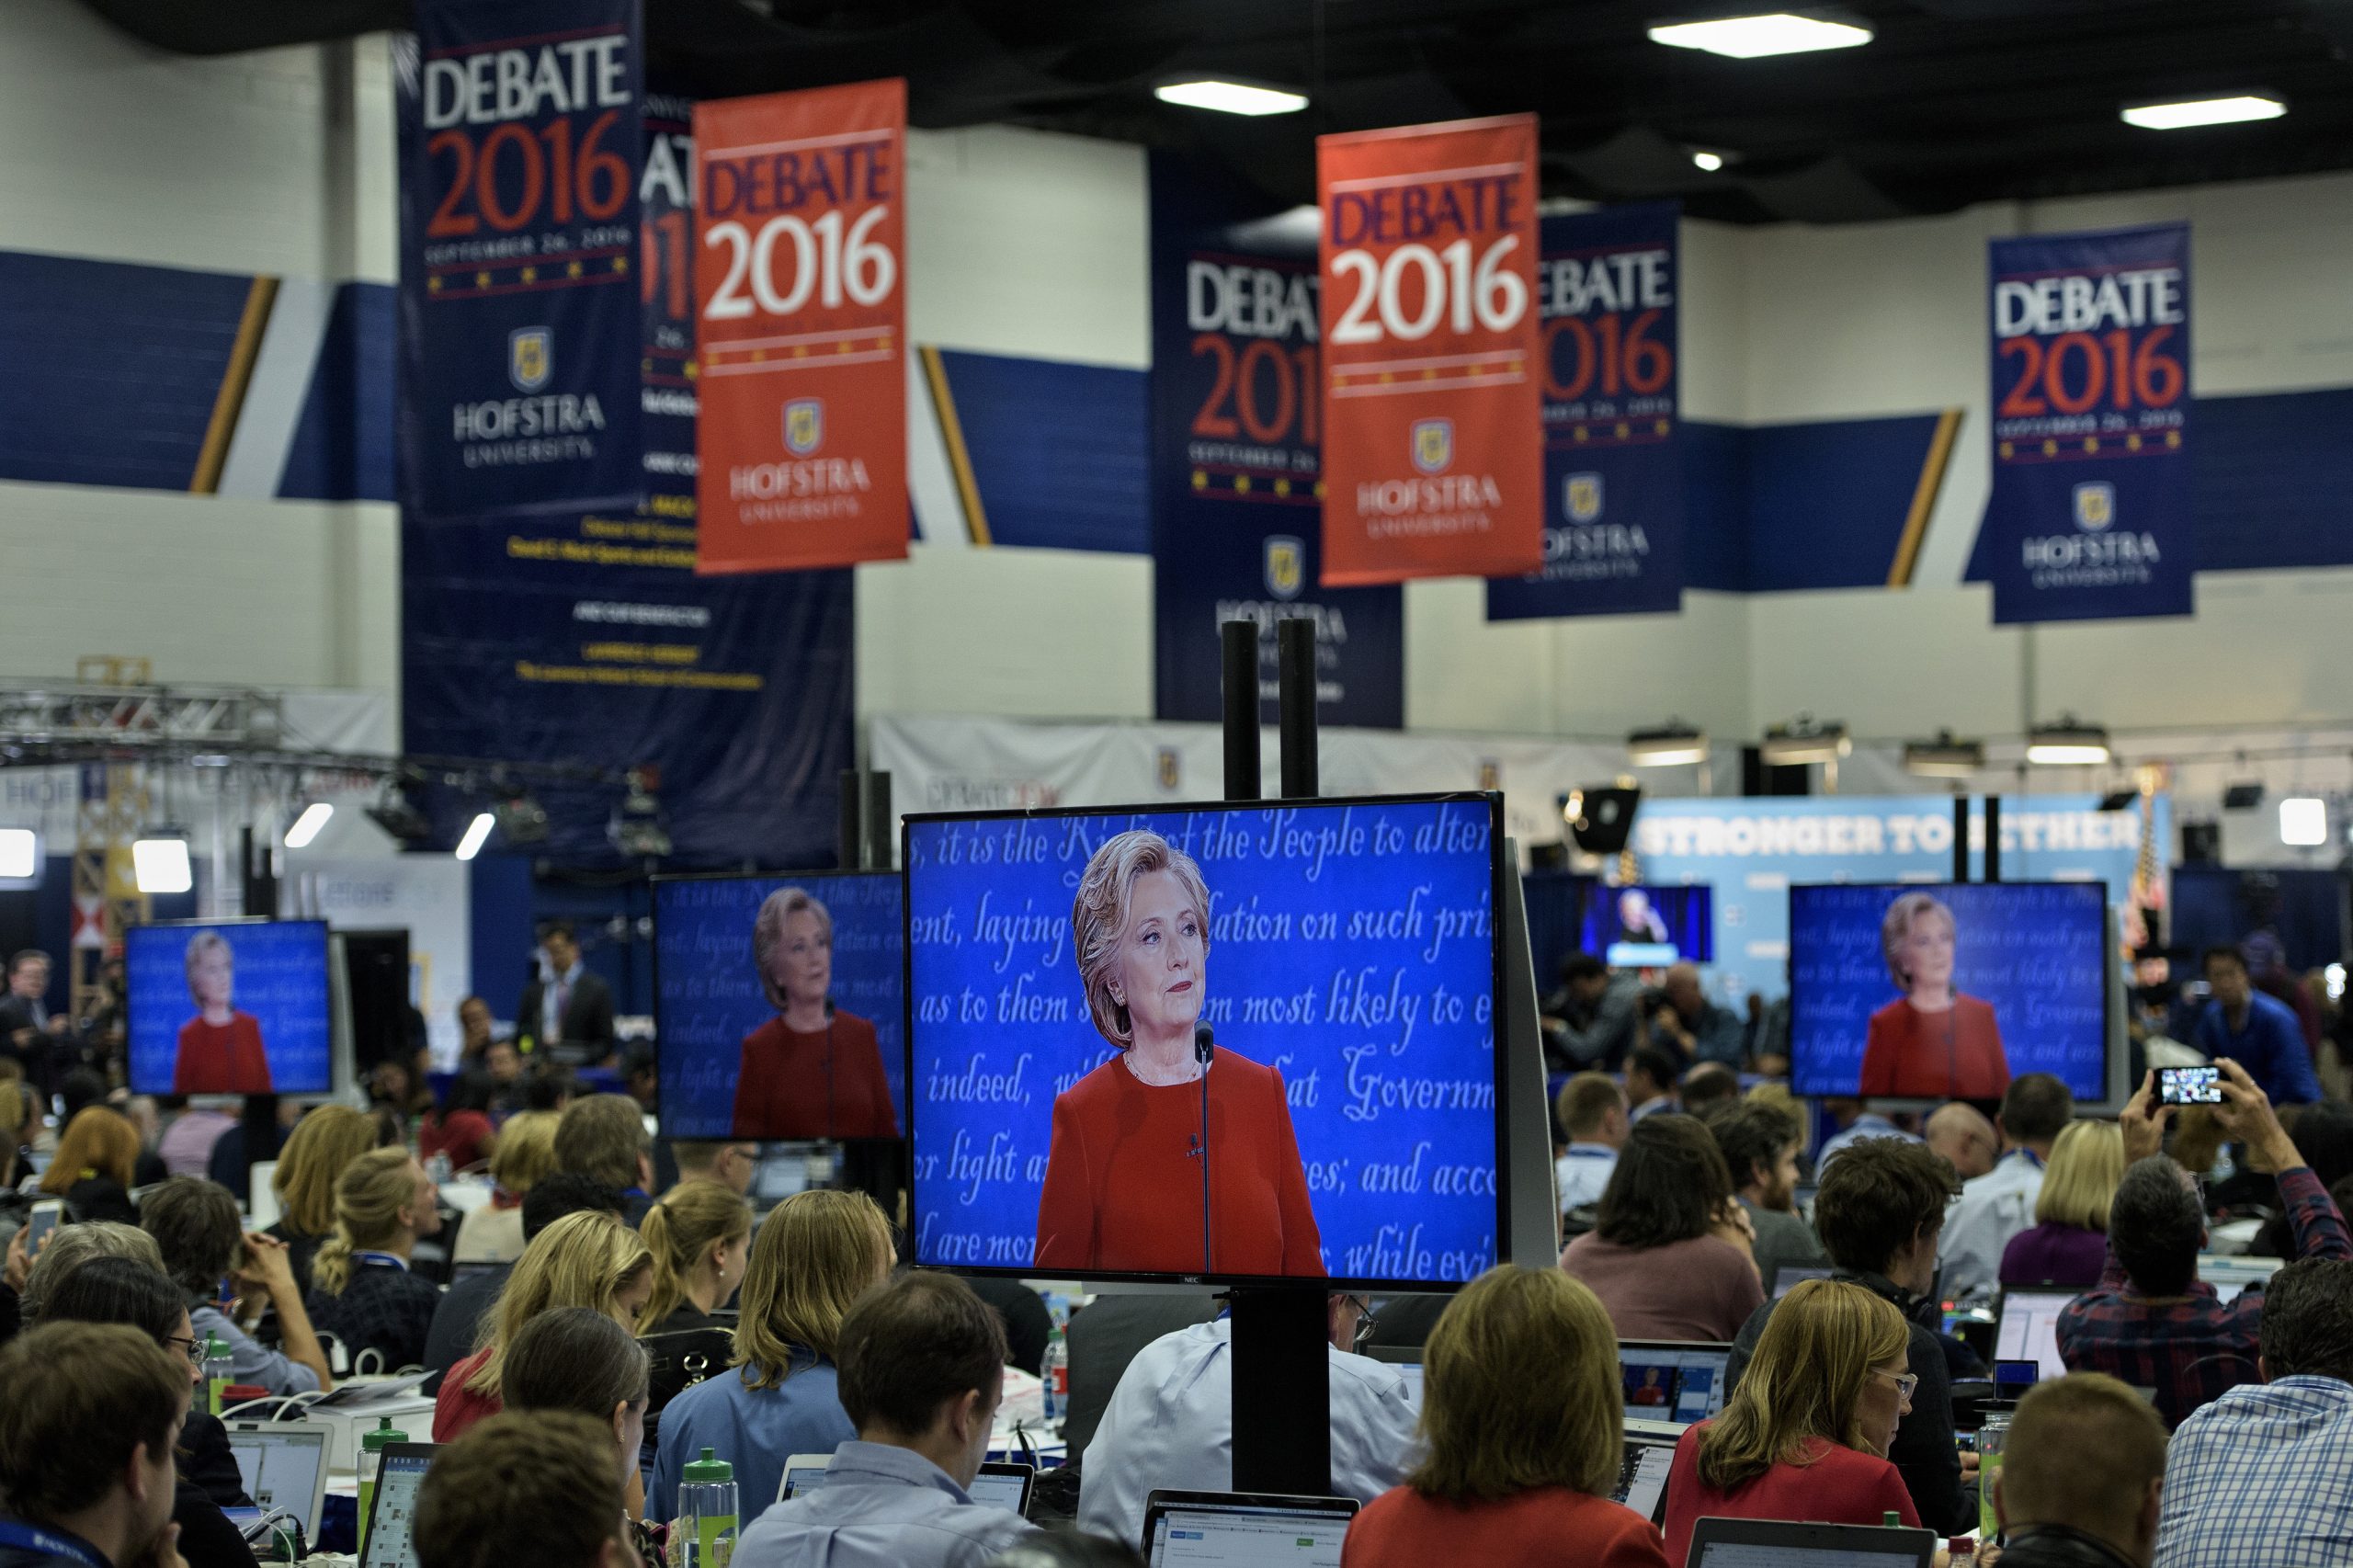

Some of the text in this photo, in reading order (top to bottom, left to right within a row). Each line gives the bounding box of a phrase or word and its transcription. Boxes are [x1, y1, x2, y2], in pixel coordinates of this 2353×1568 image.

[424, 35, 631, 130] DEBATE
[426, 111, 632, 238] 2016
[704, 140, 892, 220] DEBATE
[1331, 174, 1523, 248] DEBATE
[705, 206, 895, 319] 2016
[1330, 235, 1528, 343] 2016
[1540, 250, 1674, 318] EBATE
[1995, 270, 2184, 337] DEBATE
[1192, 334, 1322, 444] 201
[1544, 311, 1674, 401] 016
[1998, 324, 2186, 417] 2016
[453, 392, 607, 441] HOFSTRA
[462, 436, 596, 468] UNIVERSITY
[729, 457, 872, 502] HOFSTRA
[1356, 473, 1504, 517] HOFSTRA
[1540, 525, 1650, 558] OFSTRA
[2022, 530, 2161, 570] HOFSTRA
[938, 822, 962, 865] it
[969, 820, 995, 865] is
[1001, 817, 1049, 864] the
[1202, 810, 1249, 861] the
[1259, 805, 1366, 882] People
[1374, 814, 1405, 856] to
[1415, 801, 1489, 855] alter
[1639, 814, 1884, 857] STRONGER
[973, 891, 1066, 973] laying
[1302, 914, 1337, 941] on
[1347, 881, 1432, 941] such
[1423, 890, 1492, 963] pri
[920, 993, 952, 1024] as
[960, 983, 988, 1024] to
[997, 970, 1068, 1024] them
[1243, 983, 1317, 1026] most
[1325, 964, 1422, 1056] likely
[1432, 983, 1464, 1025] to
[928, 1052, 1032, 1108] indeed,
[947, 1128, 1018, 1207] light
[1362, 1142, 1431, 1194] and
[938, 1233, 981, 1263] are
[1345, 1222, 1432, 1281] while
[1439, 1234, 1496, 1282] evi
[1185, 1276, 1199, 1284] NEC
